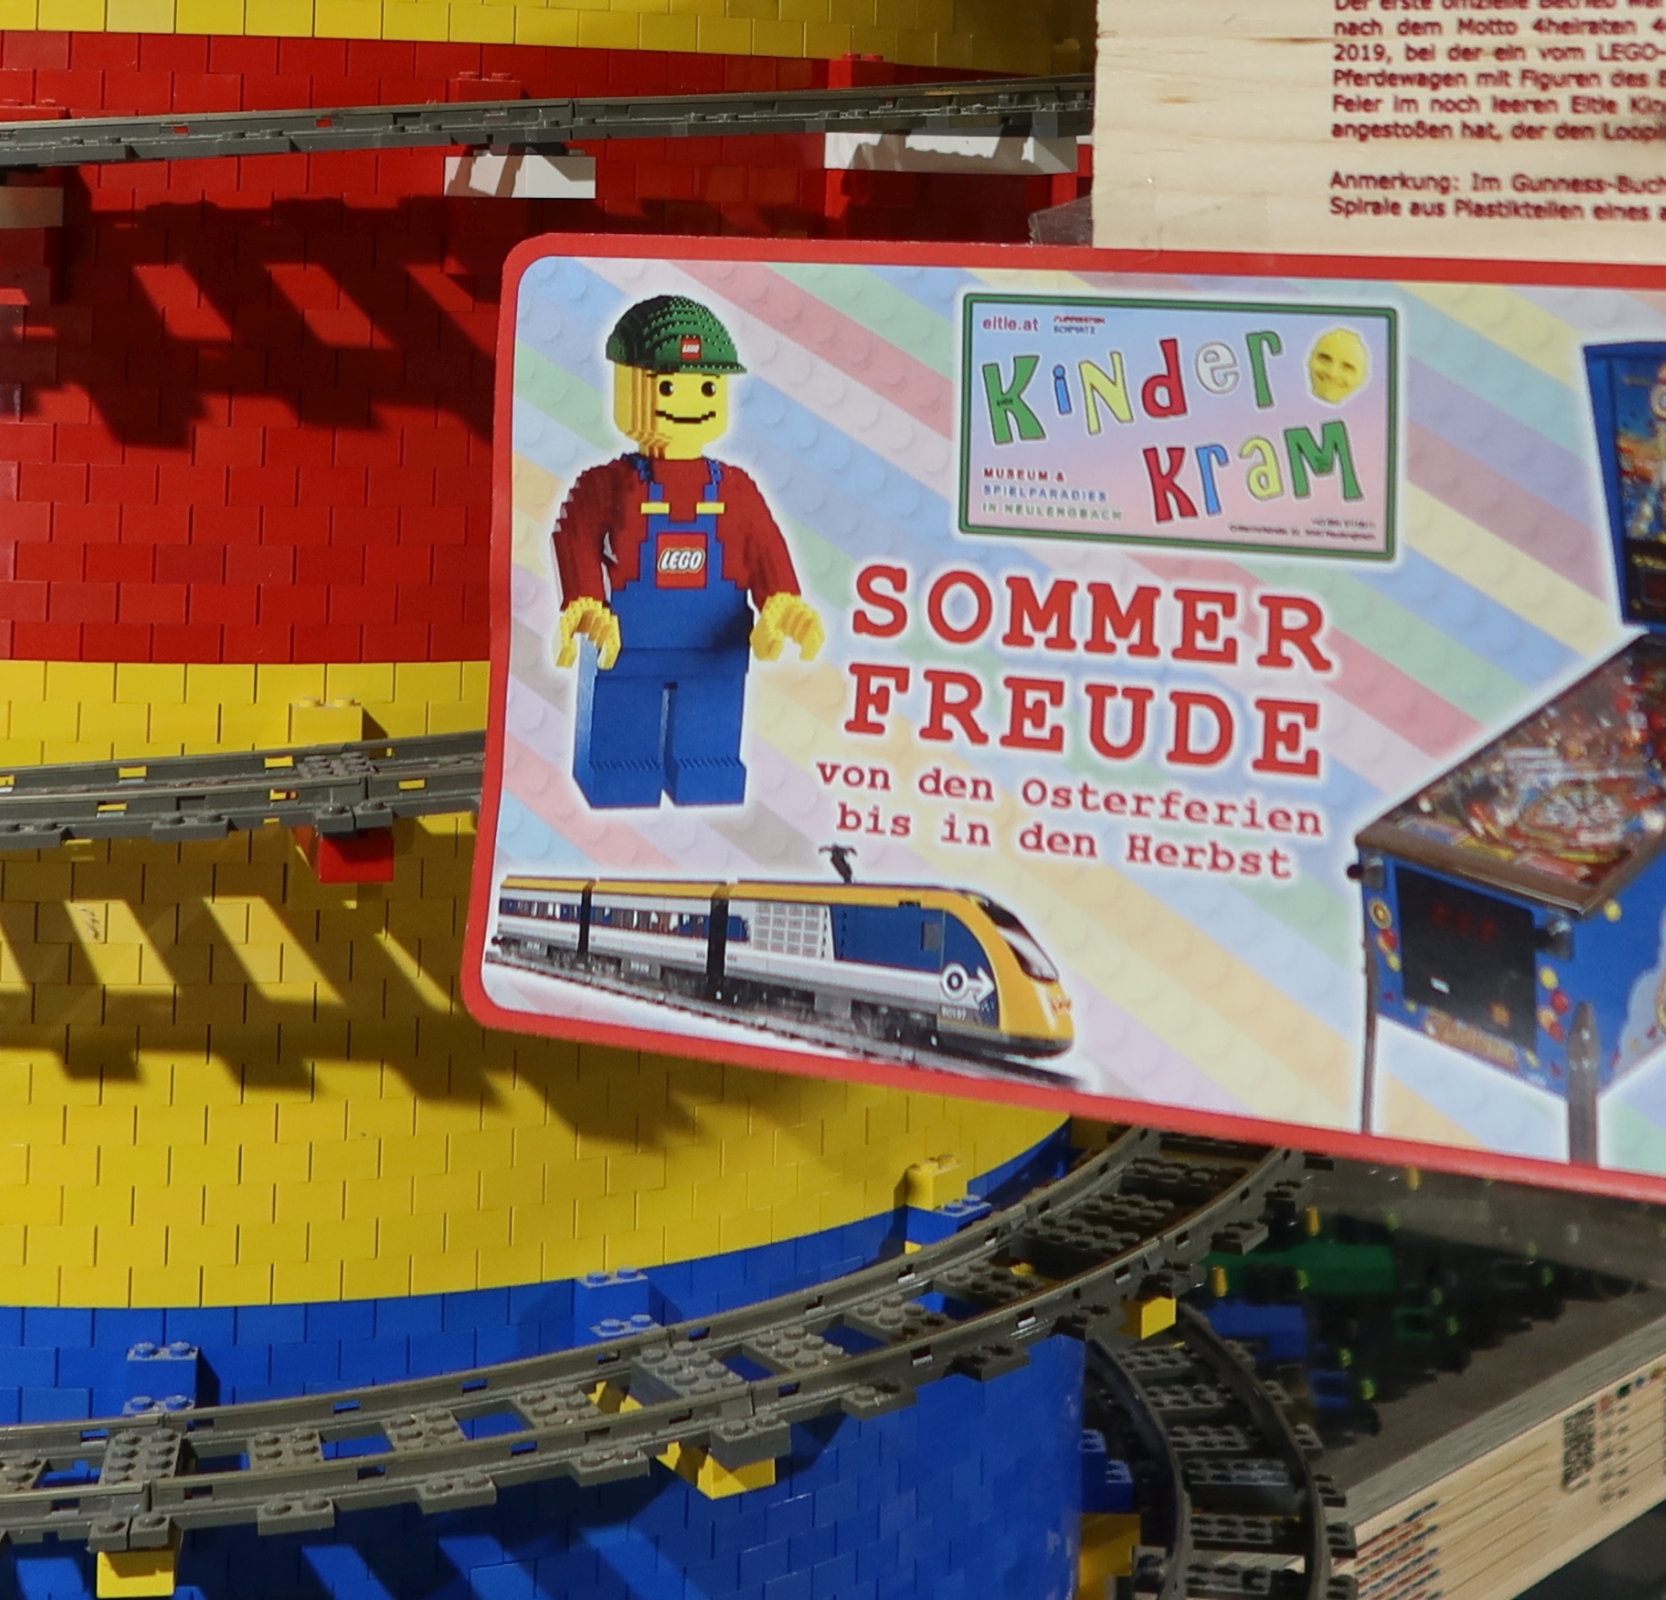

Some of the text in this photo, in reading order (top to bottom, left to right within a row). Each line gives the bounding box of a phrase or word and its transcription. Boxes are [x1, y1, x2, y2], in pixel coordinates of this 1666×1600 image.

[1333, 19, 1383, 36] nach
[1397, 19, 1442, 36] dem
[1457, 18, 1517, 35] Motto
[1532, 17, 1635, 35] 4heiraten
[1333, 42, 1584, 63] 2019, bei der vom
[1332, 69, 1600, 91] Pferdewagen Figuren
[1332, 93, 1616, 114] Feier noch leeren Eitle
[1330, 121, 1597, 143] angestoßen hat, der den
[1329, 171, 1459, 194] Anmerkung:
[1471, 172, 1501, 191] Im
[1329, 195, 1652, 220] Spirale aus Plastikteilen eines
[983, 315, 1039, 331] eitle.at
[984, 467, 1065, 482] MUSEUM &
[984, 484, 1107, 502] SPIELPARADIES
[983, 503, 1123, 520] IN NEULENGBACH
[657, 549, 706, 574] LEGO
[852, 564, 1332, 672] SOMMER
[844, 663, 1320, 778] FREUDE
[816, 762, 1324, 836] von den Osterferien
[837, 802, 1292, 880] bis in den Herbst
